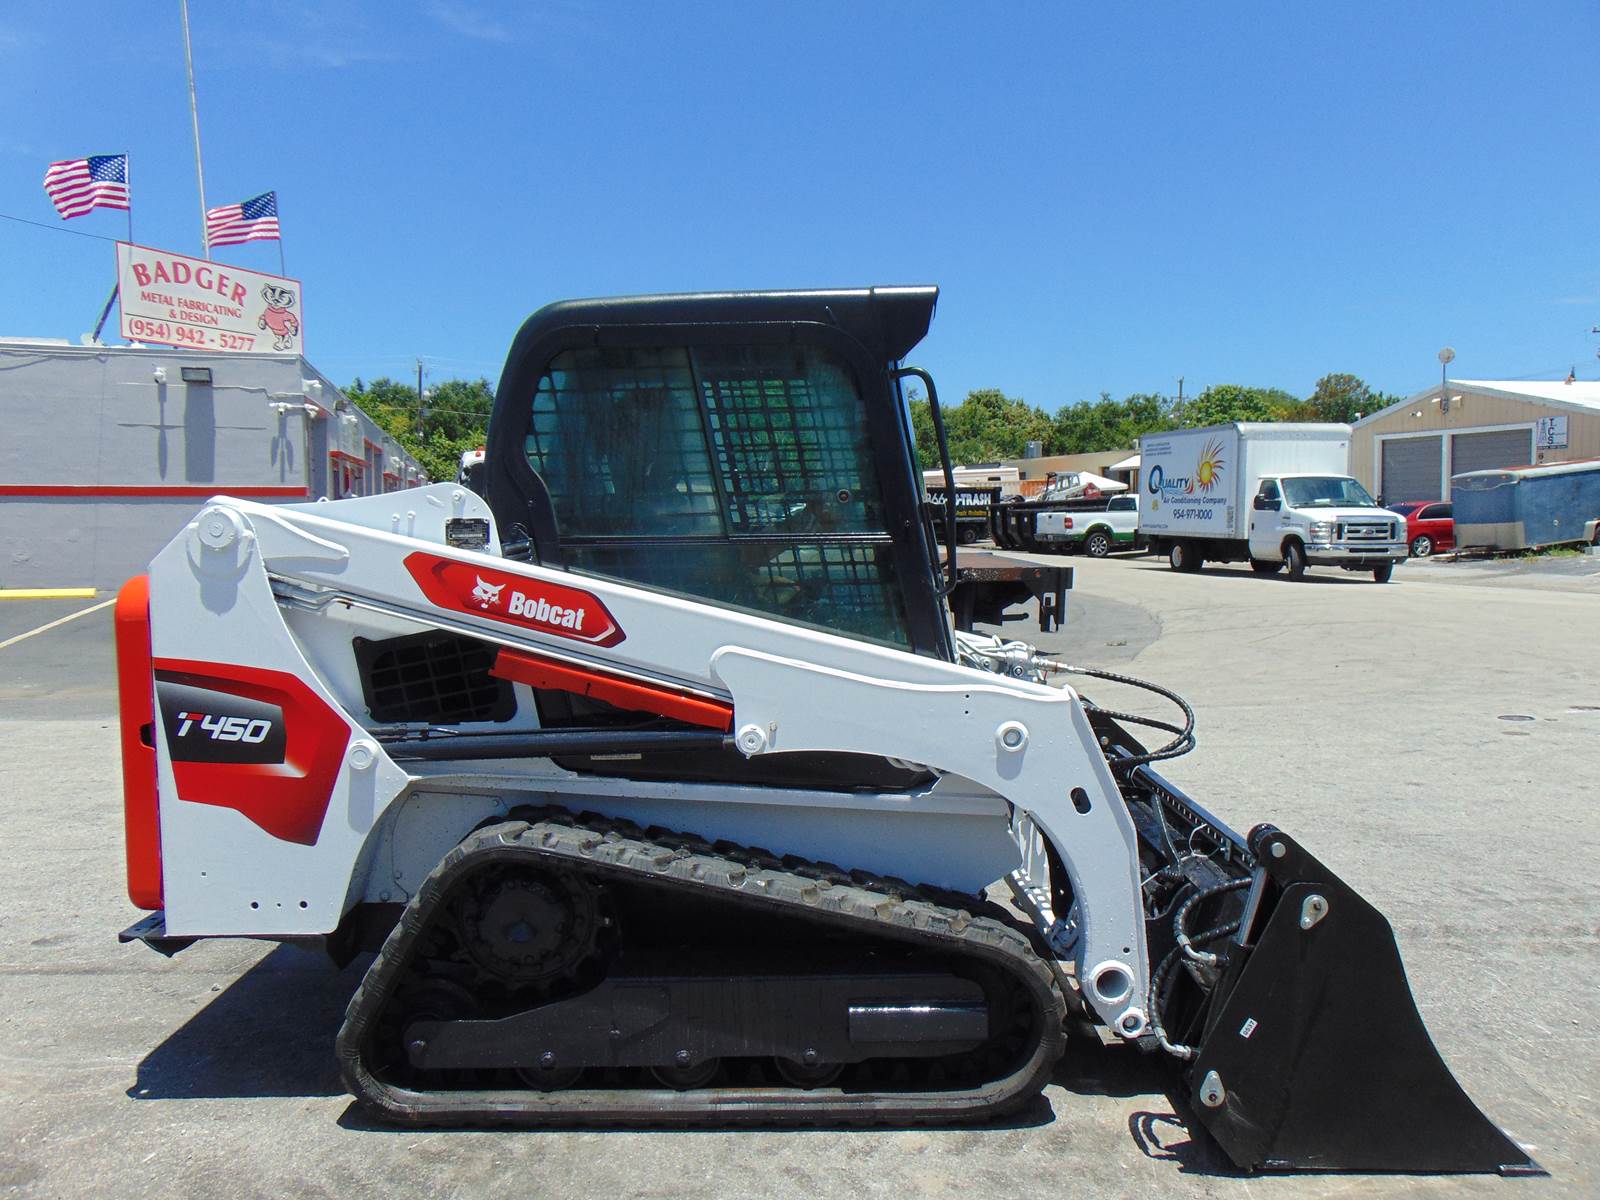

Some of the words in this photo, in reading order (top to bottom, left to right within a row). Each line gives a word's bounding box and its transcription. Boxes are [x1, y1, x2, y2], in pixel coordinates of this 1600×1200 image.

[133, 261, 247, 307] BADGER
[141, 291, 175, 306] METAL
[178, 297, 242, 318] FABRICATING
[169, 309, 177, 319] &
[180, 310, 218, 326] DESIGN
[128, 319, 170, 340] (954)
[175, 326, 206, 345] 942
[219, 334, 257, 351] 5277
[1202, 497, 1227, 505] Company
[508, 591, 585, 630] Bobcat
[178, 712, 272, 743] T450
